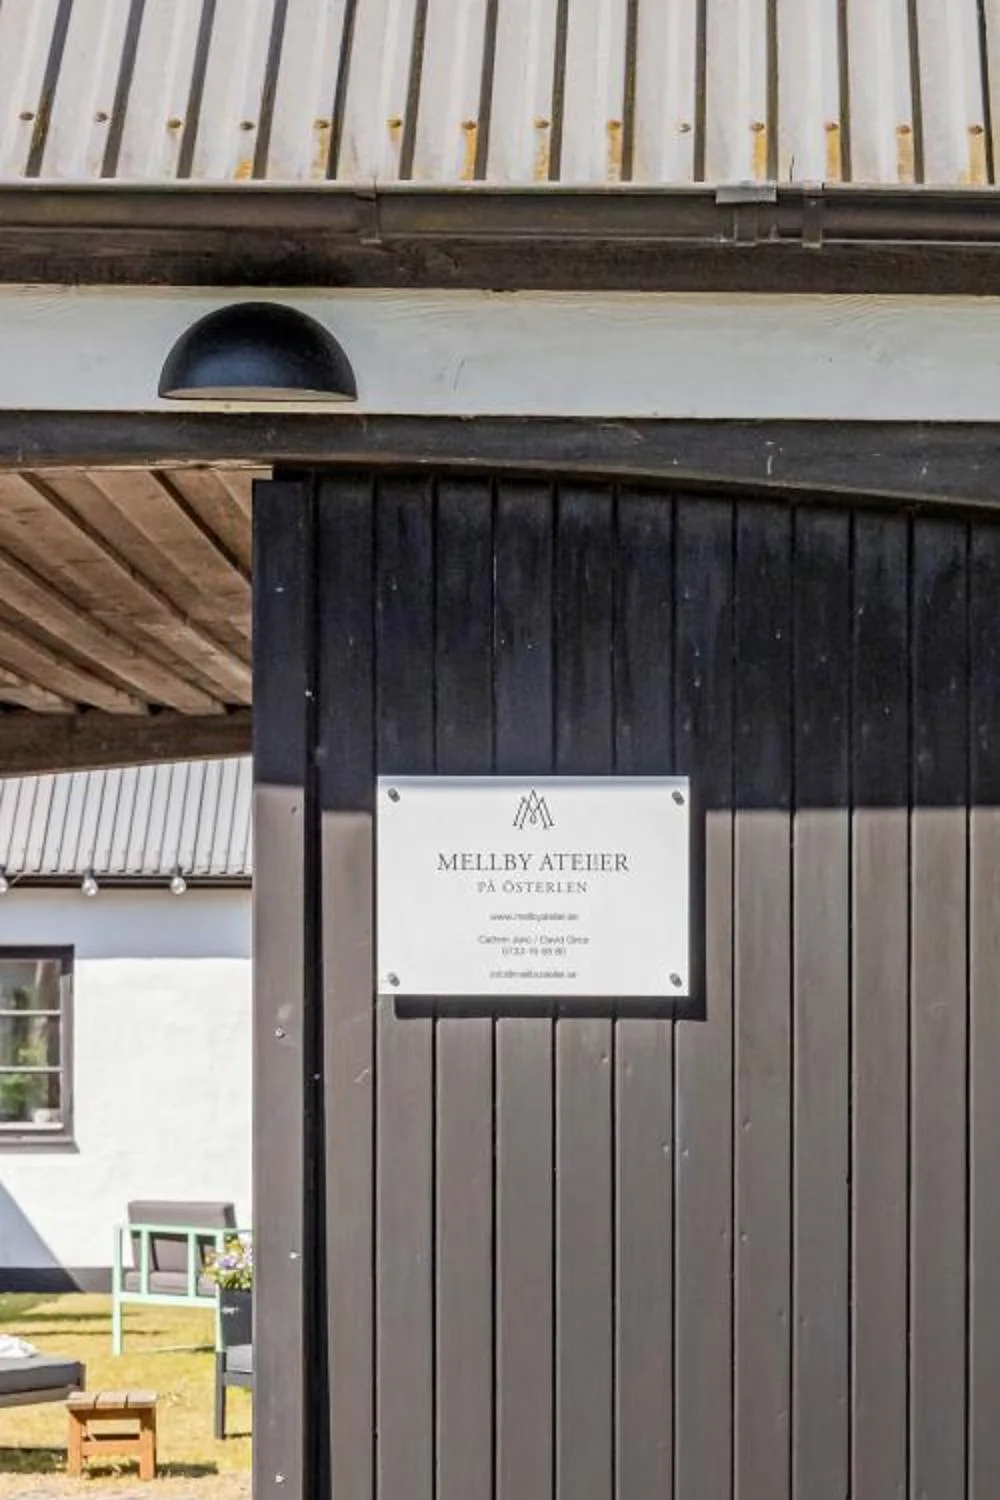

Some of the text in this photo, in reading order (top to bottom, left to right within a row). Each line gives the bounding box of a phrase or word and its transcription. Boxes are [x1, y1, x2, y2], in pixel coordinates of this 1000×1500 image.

[436, 853, 630, 871] MELLBY ATELIER
[476, 879, 588, 893] PÅ ÖSTERLEN
